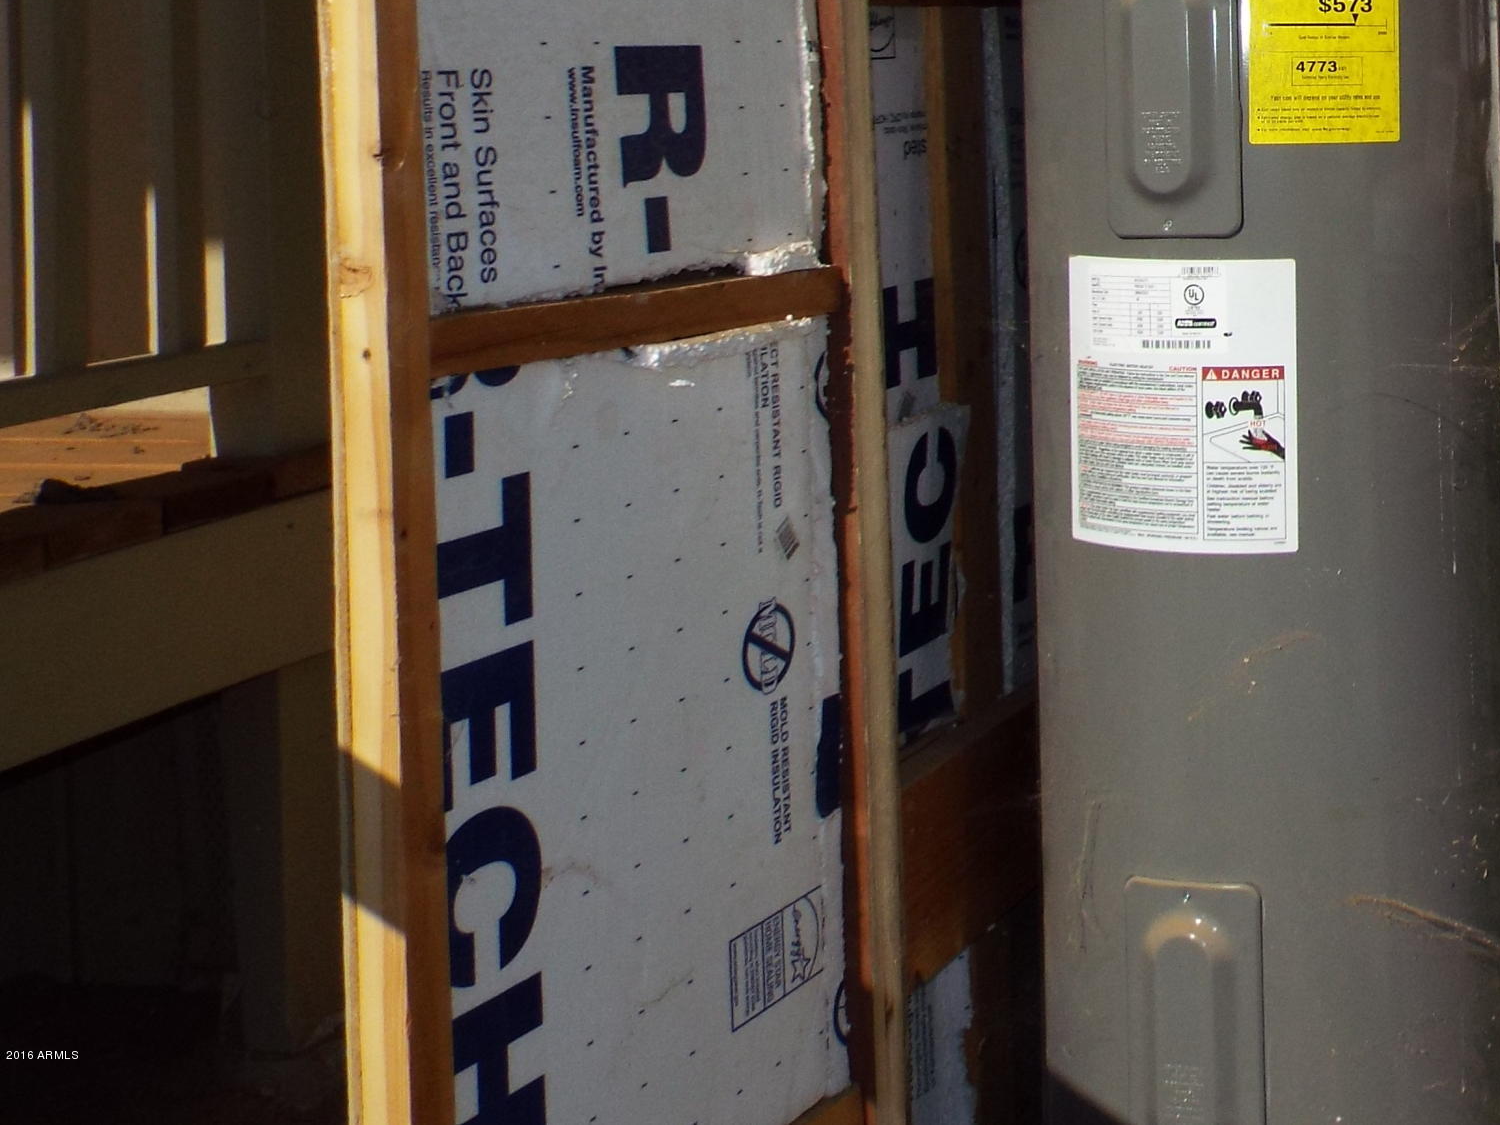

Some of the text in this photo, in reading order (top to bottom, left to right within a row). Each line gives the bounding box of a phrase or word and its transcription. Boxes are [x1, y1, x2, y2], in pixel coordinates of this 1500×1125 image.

[1296, 60, 1338, 73] 4773
[427, 143, 438, 211] excellent
[470, 68, 499, 284] Skin Surfaces
[581, 66, 606, 223] Manufactured
[437, 70, 468, 308] Front and Back
[589, 231, 606, 258] by
[1221, 368, 1280, 379] DANGER
[771, 375, 782, 459] RESISTANT
[774, 465, 784, 508] RIGID
[770, 701, 782, 845] RIGID INSULATION
[779, 696, 792, 833] MOLD RESISTANT
